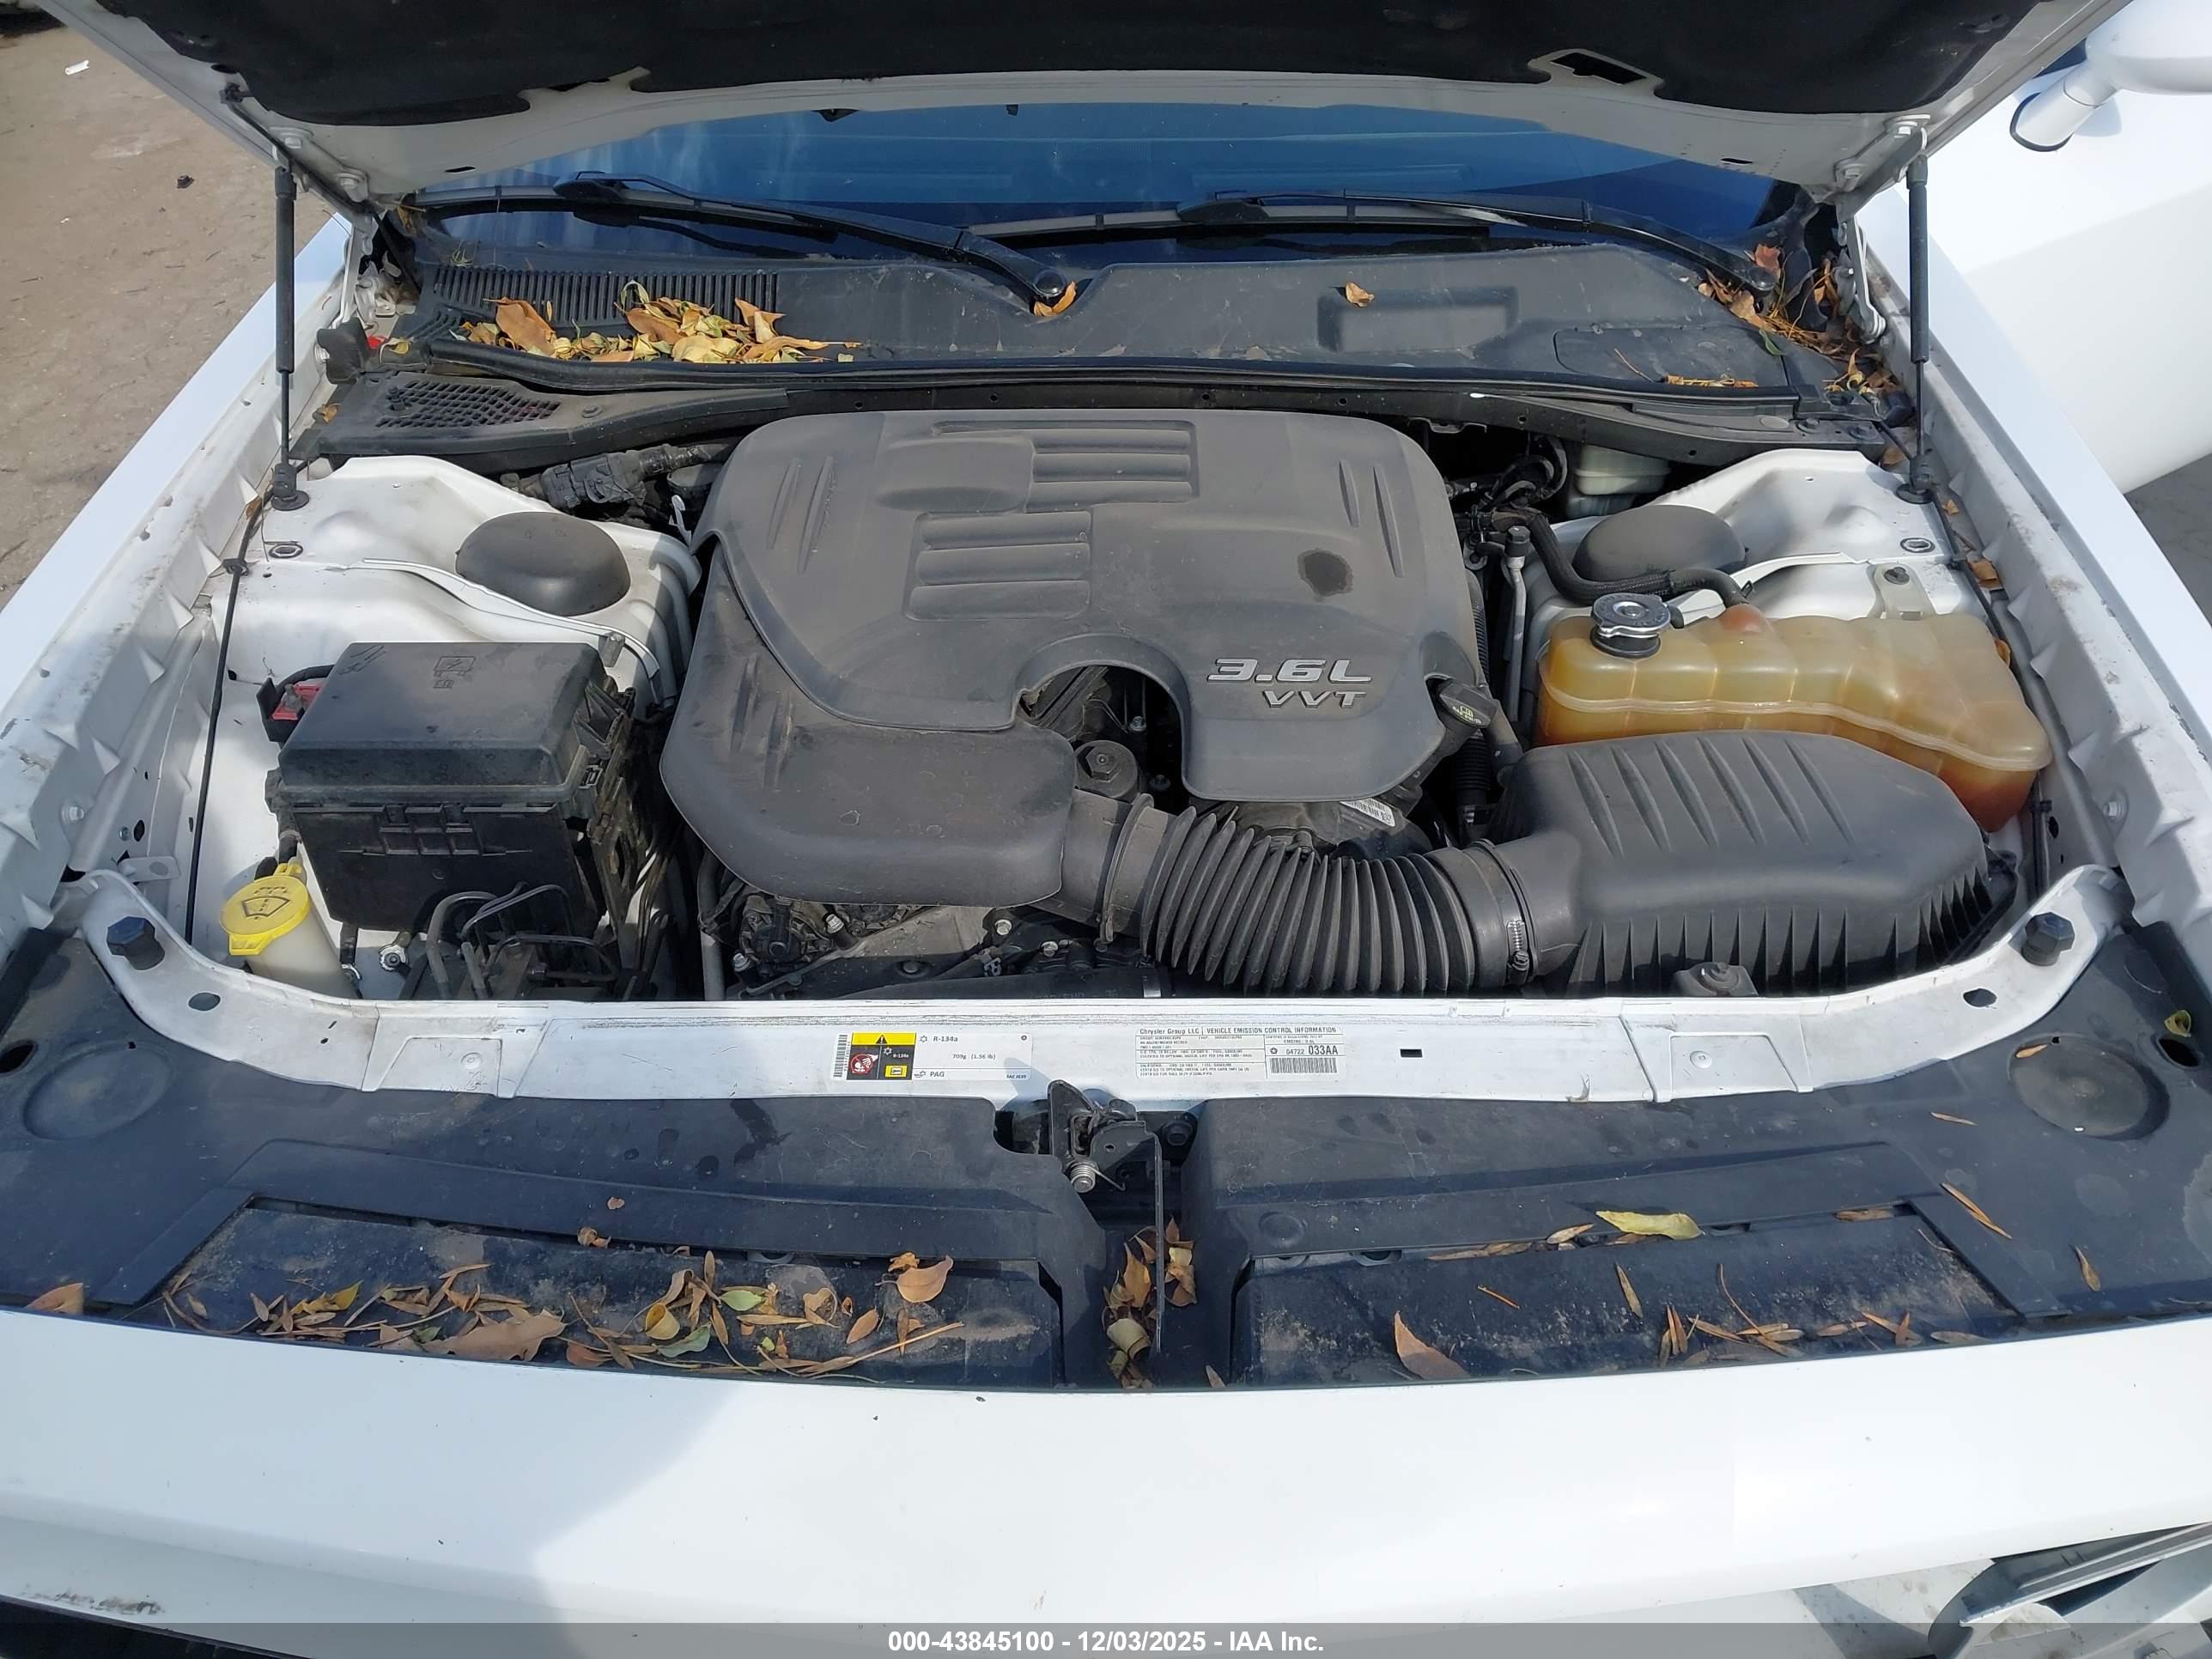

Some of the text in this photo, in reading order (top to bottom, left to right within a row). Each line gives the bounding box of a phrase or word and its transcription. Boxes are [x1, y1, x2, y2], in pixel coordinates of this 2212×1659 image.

[1207, 659, 1372, 683] 3.6L
[1263, 690, 1367, 708] VVT
[1308, 1045, 1339, 1055] 033AA
